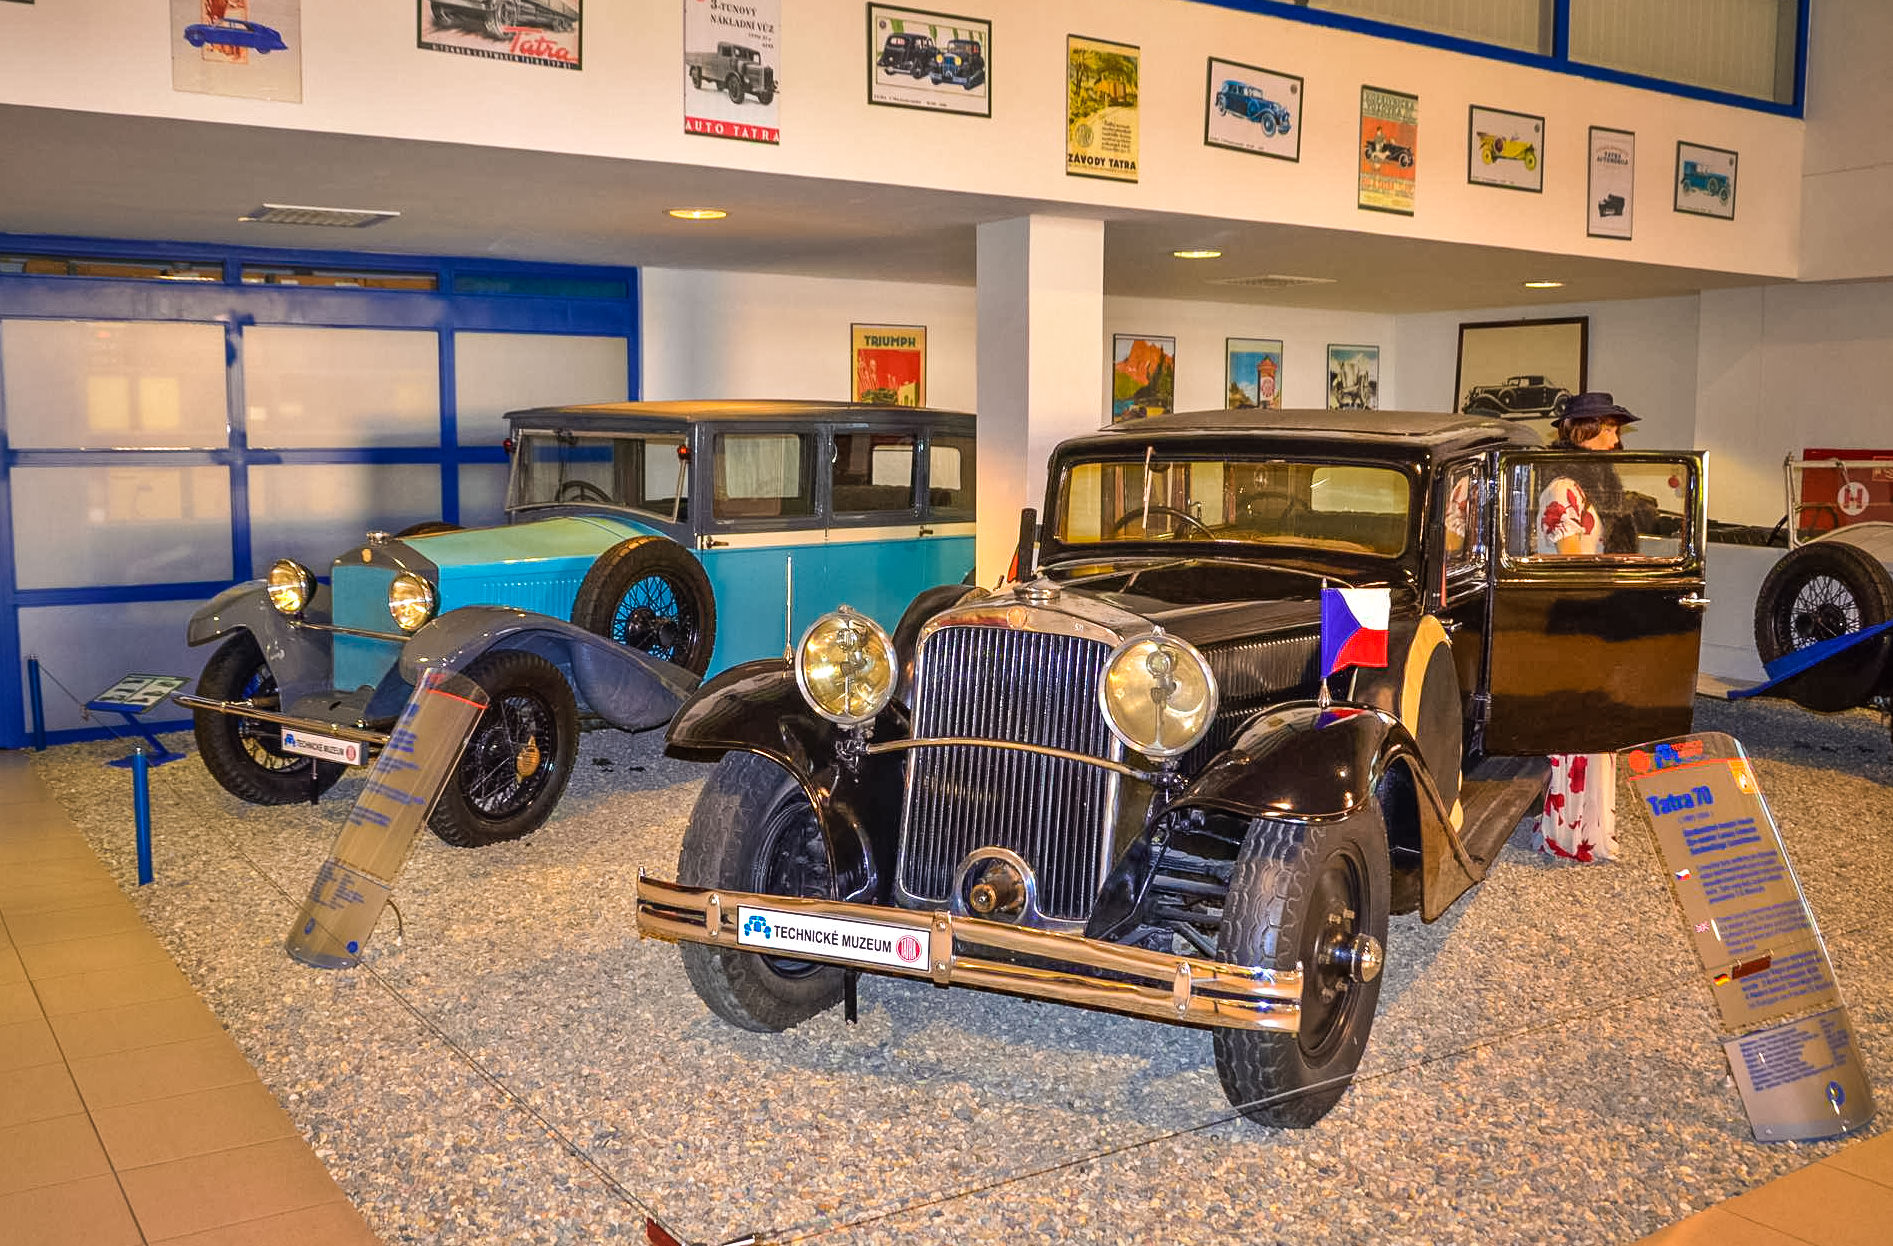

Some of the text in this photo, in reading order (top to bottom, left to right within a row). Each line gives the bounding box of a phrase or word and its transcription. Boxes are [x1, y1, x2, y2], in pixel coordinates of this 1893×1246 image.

[503, 25, 578, 62] Tatra
[685, 119, 780, 142] AUTO TATRA
[1068, 152, 1106, 166] ZÁVODY
[1109, 158, 1136, 170] TATRA
[864, 335, 916, 347] TRIUMPH
[1844, 487, 1863, 509] H
[1646, 785, 1714, 816] Tatra 70
[773, 924, 840, 946] TECHNICKÉ
[841, 933, 892, 953] MUZEUM
